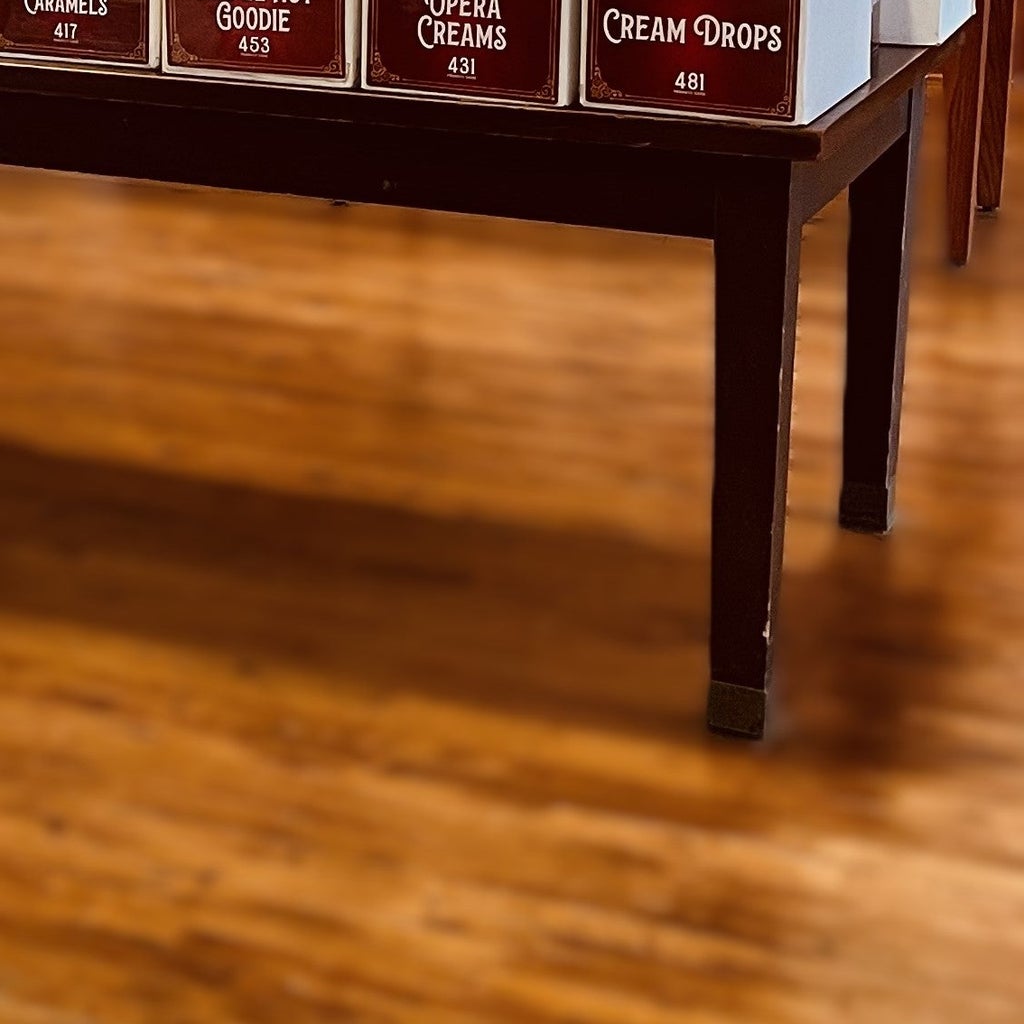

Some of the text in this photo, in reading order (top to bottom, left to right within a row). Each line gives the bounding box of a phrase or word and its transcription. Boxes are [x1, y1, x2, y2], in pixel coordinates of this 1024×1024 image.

[216, 1, 291, 32] GOODIE
[54, 23, 78, 39] 417
[417, 15, 507, 50] CREAMS
[603, 8, 782, 52] CREAM DROPS
[238, 36, 270, 53] 453
[448, 57, 475, 75] 431
[674, 71, 705, 91] 481
